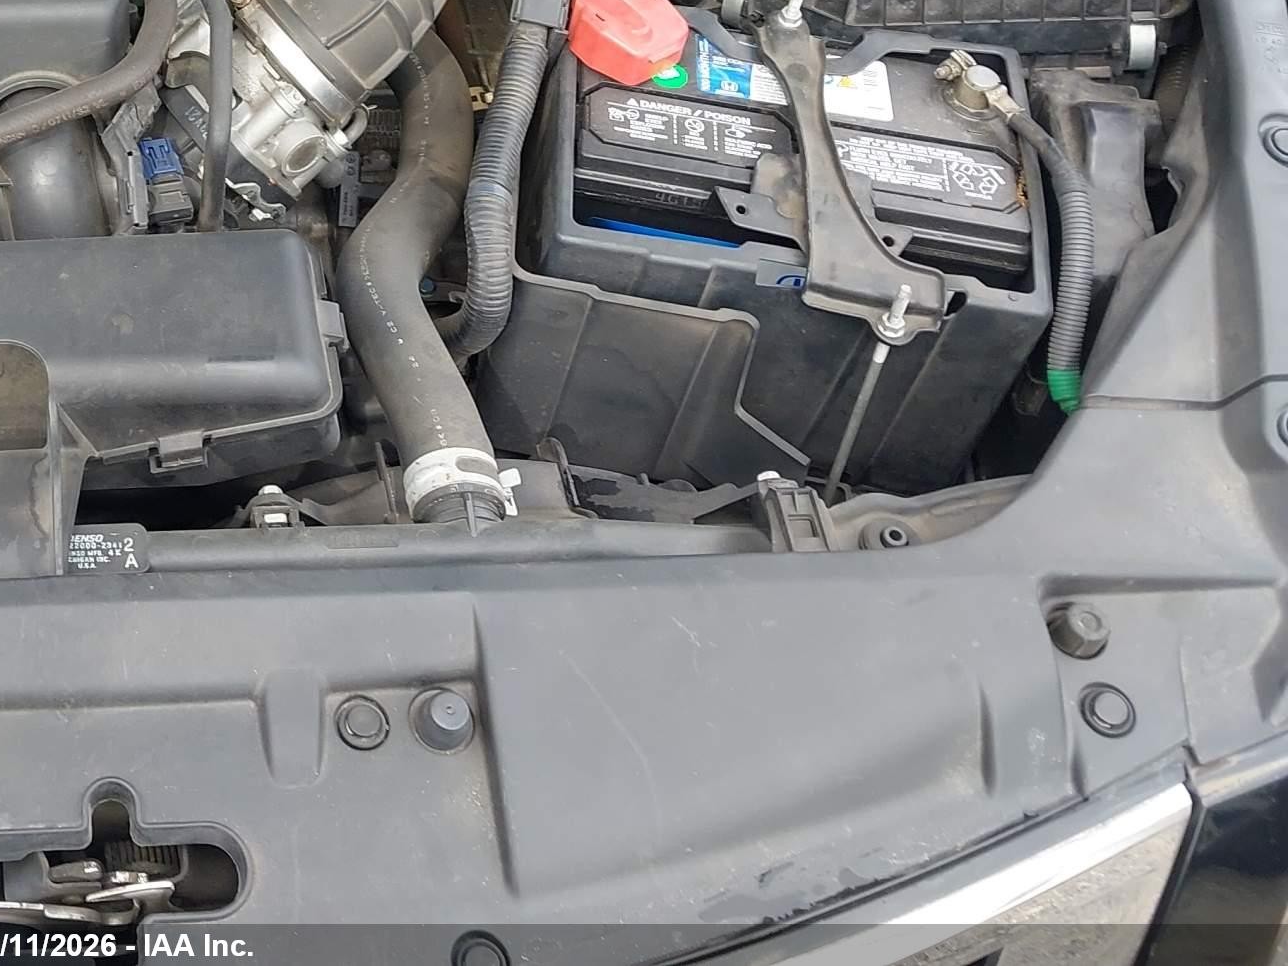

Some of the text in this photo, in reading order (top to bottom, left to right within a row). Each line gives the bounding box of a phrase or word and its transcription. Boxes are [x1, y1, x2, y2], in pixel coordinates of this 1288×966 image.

[639, 99, 692, 117] DANGER
[704, 110, 752, 126] POISON
[123, 537, 135, 552] 2
[124, 553, 139, 569] A
